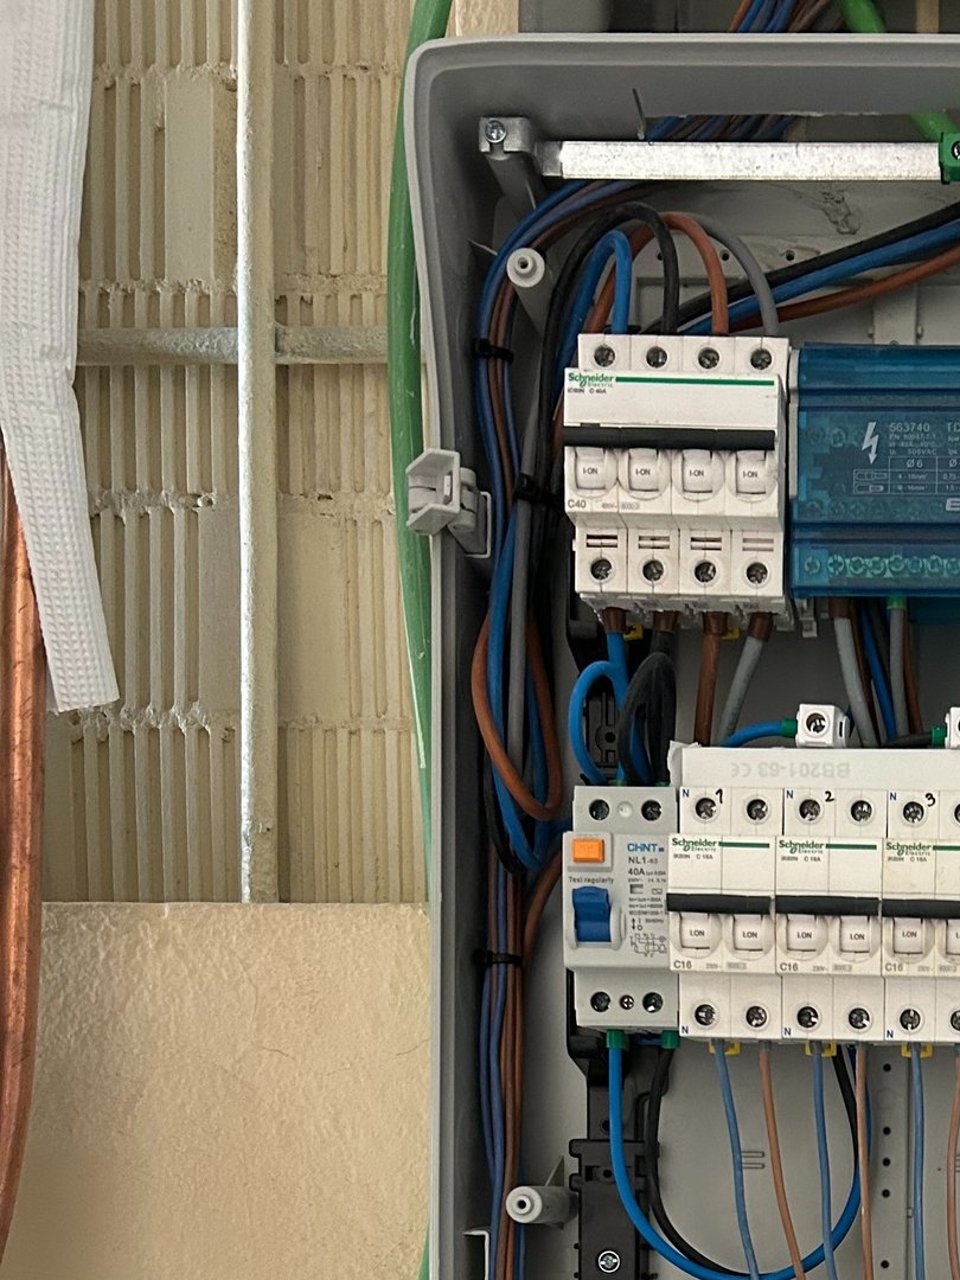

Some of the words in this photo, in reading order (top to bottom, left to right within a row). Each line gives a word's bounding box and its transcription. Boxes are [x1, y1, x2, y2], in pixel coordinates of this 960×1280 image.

[568, 372, 614, 388] Schneider
[567, 499, 587, 509] C40
[682, 789, 690, 798] N
[786, 790, 794, 799] N
[825, 790, 834, 802] 2
[889, 792, 896, 800] N
[925, 792, 936, 806] 3
[672, 838, 718, 852] Schneider
[779, 840, 824, 854] Schneider
[886, 842, 932, 856] Schneider
[628, 868, 645, 876] 40A
[584, 876, 614, 884] regularly
[681, 1026, 689, 1034] N
[784, 1027, 791, 1036] N
[886, 1030, 893, 1039] N
